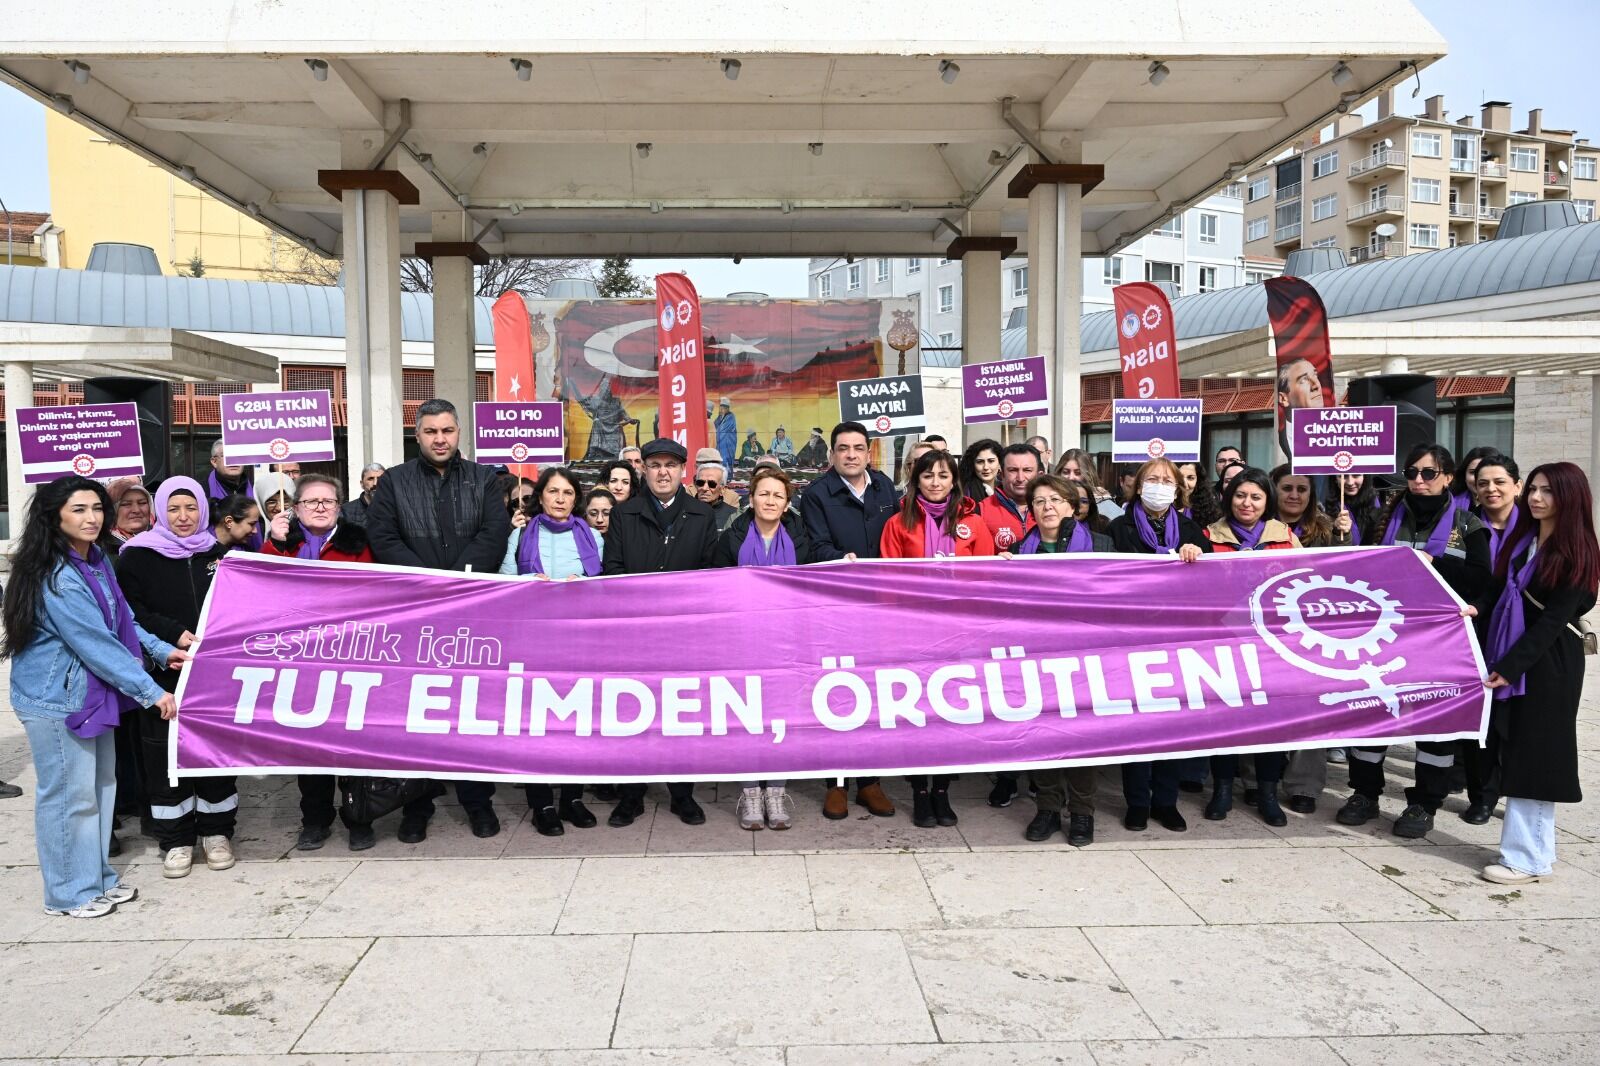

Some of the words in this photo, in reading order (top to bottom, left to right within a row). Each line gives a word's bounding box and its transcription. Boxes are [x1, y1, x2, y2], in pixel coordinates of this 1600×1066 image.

[980, 362, 1026, 376] İSTANBUL
[974, 371, 1034, 388] SÖZLEŞMESİ
[850, 380, 911, 398] SAVAŞA
[984, 386, 1025, 399] YAŞATIR
[234, 400, 272, 413] 6284
[275, 396, 318, 412] ETKİN
[857, 399, 907, 416] HAYIR!
[1115, 406, 1157, 415] KORUMA,
[1158, 406, 1199, 414] AKLAMA
[37, 411, 76, 421] Dilimiz,
[495, 409, 518, 421] ILO
[520, 409, 543, 421] 190
[1119, 414, 1154, 424] FAİLLERİ
[1155, 415, 1195, 424] YARGILA!
[1320, 409, 1364, 421] KADIN
[19, 422, 59, 432] Dinimiz
[60, 422, 74, 430] ne
[75, 420, 109, 429] olursa
[109, 419, 136, 427] olsun
[227, 415, 327, 431] UYGULANSIN!
[1303, 420, 1384, 435] CİNAYETLERİ
[37, 433, 58, 444] göz
[59, 430, 122, 442] yaşlarımızın
[479, 426, 560, 438] imzalansın!
[53, 442, 82, 452] rengi
[83, 440, 110, 451] aynı!
[1308, 434, 1379, 448] POLİTİKTİR!
[242, 619, 402, 662] eşitlik
[416, 624, 502, 669] için
[231, 665, 384, 731] TUT
[404, 661, 788, 745] ELİMDEN,
[811, 642, 1269, 732] ÖRGÜTLEN!
[1346, 698, 1380, 711] KADIN
[1401, 687, 1461, 704] KOMİSYONU
